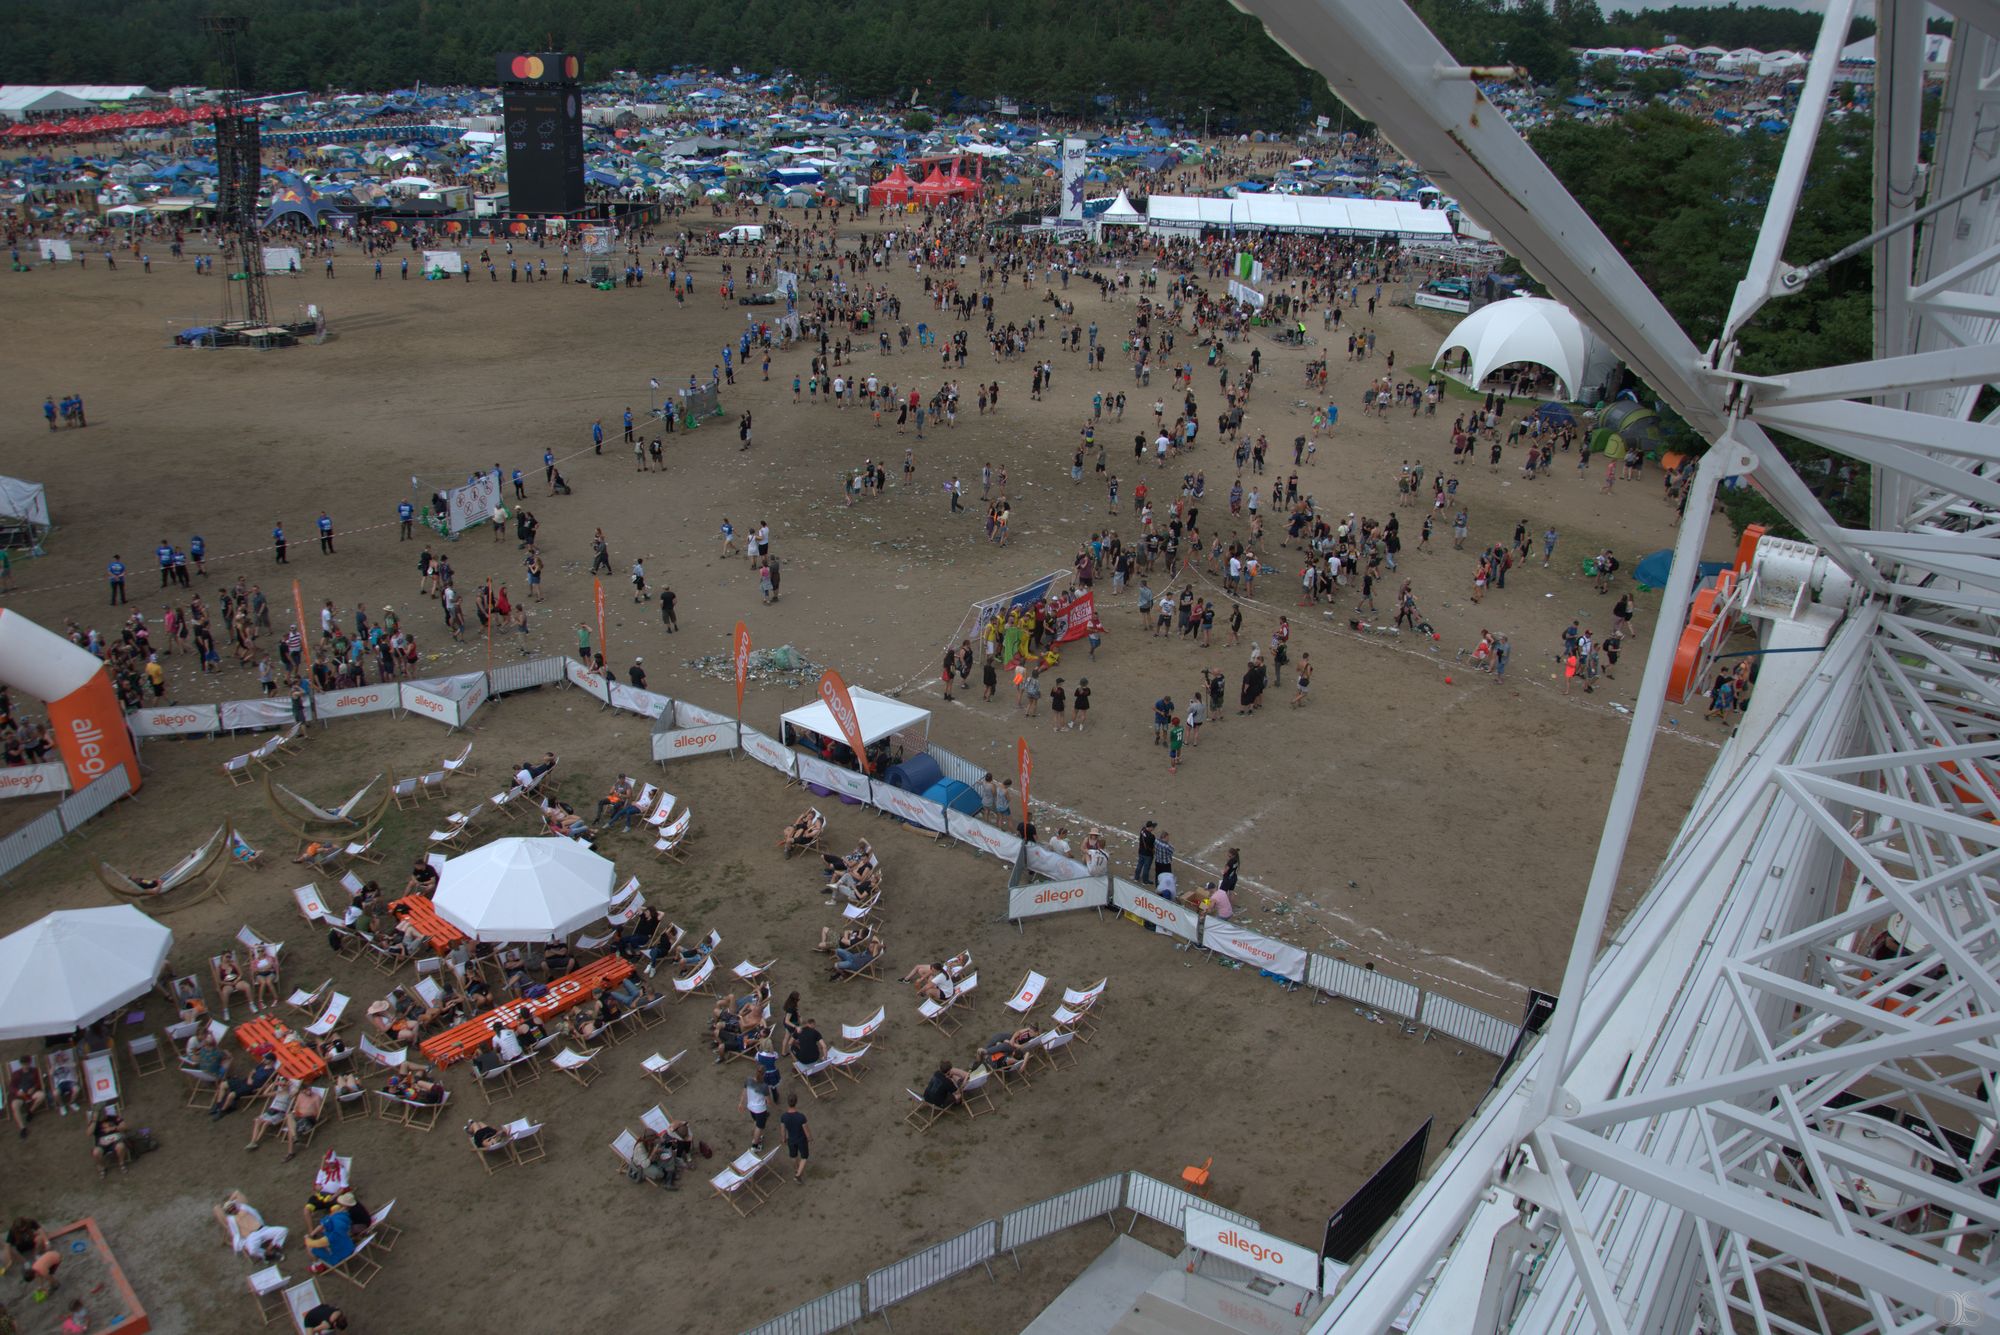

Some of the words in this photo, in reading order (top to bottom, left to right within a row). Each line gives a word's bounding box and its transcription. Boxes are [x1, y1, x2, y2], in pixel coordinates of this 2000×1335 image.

[336, 693, 379, 708] allegro
[415, 695, 444, 712] allegro
[152, 714, 197, 726] allegro
[674, 734, 716, 747] allegro
[1034, 888, 1083, 904] allegro
[1134, 896, 1176, 922] allegro
[1232, 938, 1276, 960] #allegropl
[1217, 1230, 1283, 1264] allegro
